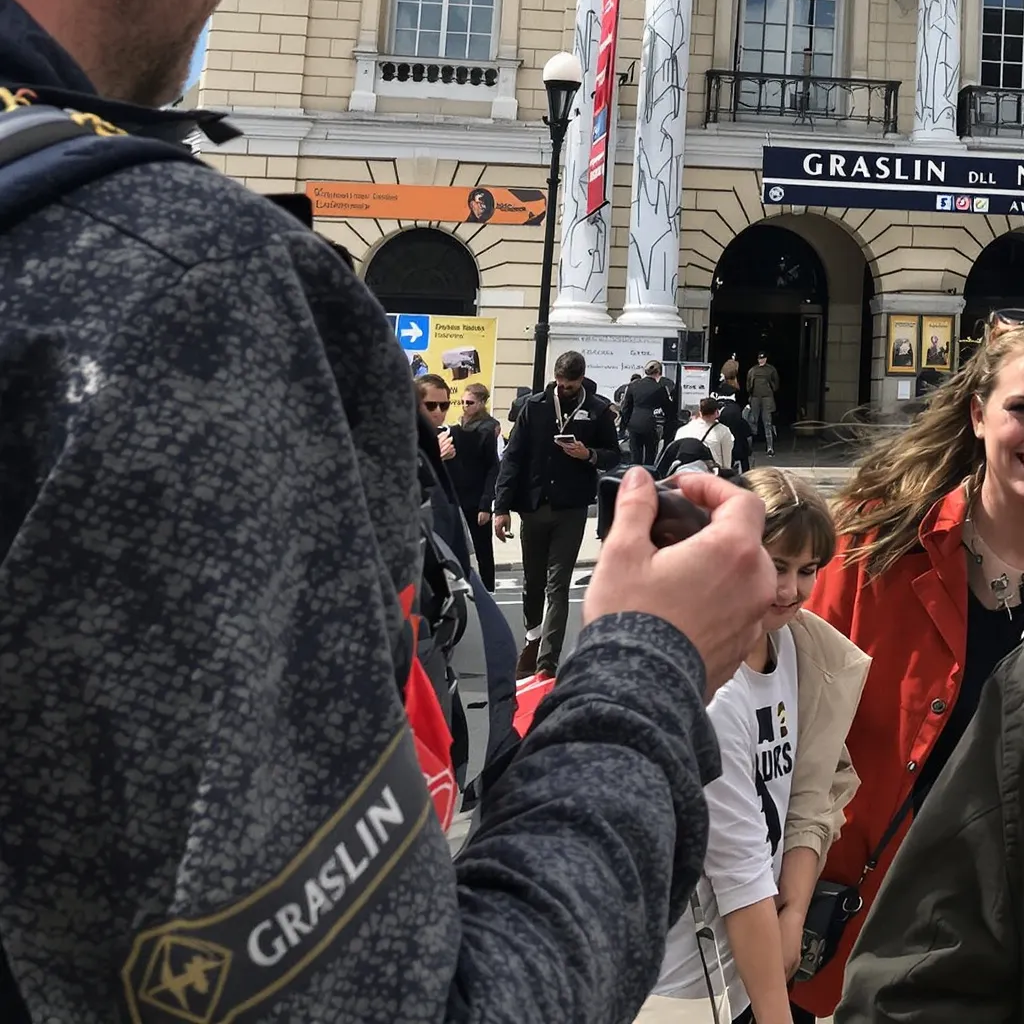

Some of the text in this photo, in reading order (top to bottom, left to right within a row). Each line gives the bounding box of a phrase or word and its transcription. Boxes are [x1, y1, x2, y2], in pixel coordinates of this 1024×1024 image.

[802, 152, 946, 182] GRASLIN
[968, 170, 997, 185] DLL
[247, 784, 404, 967] GRASLIN
